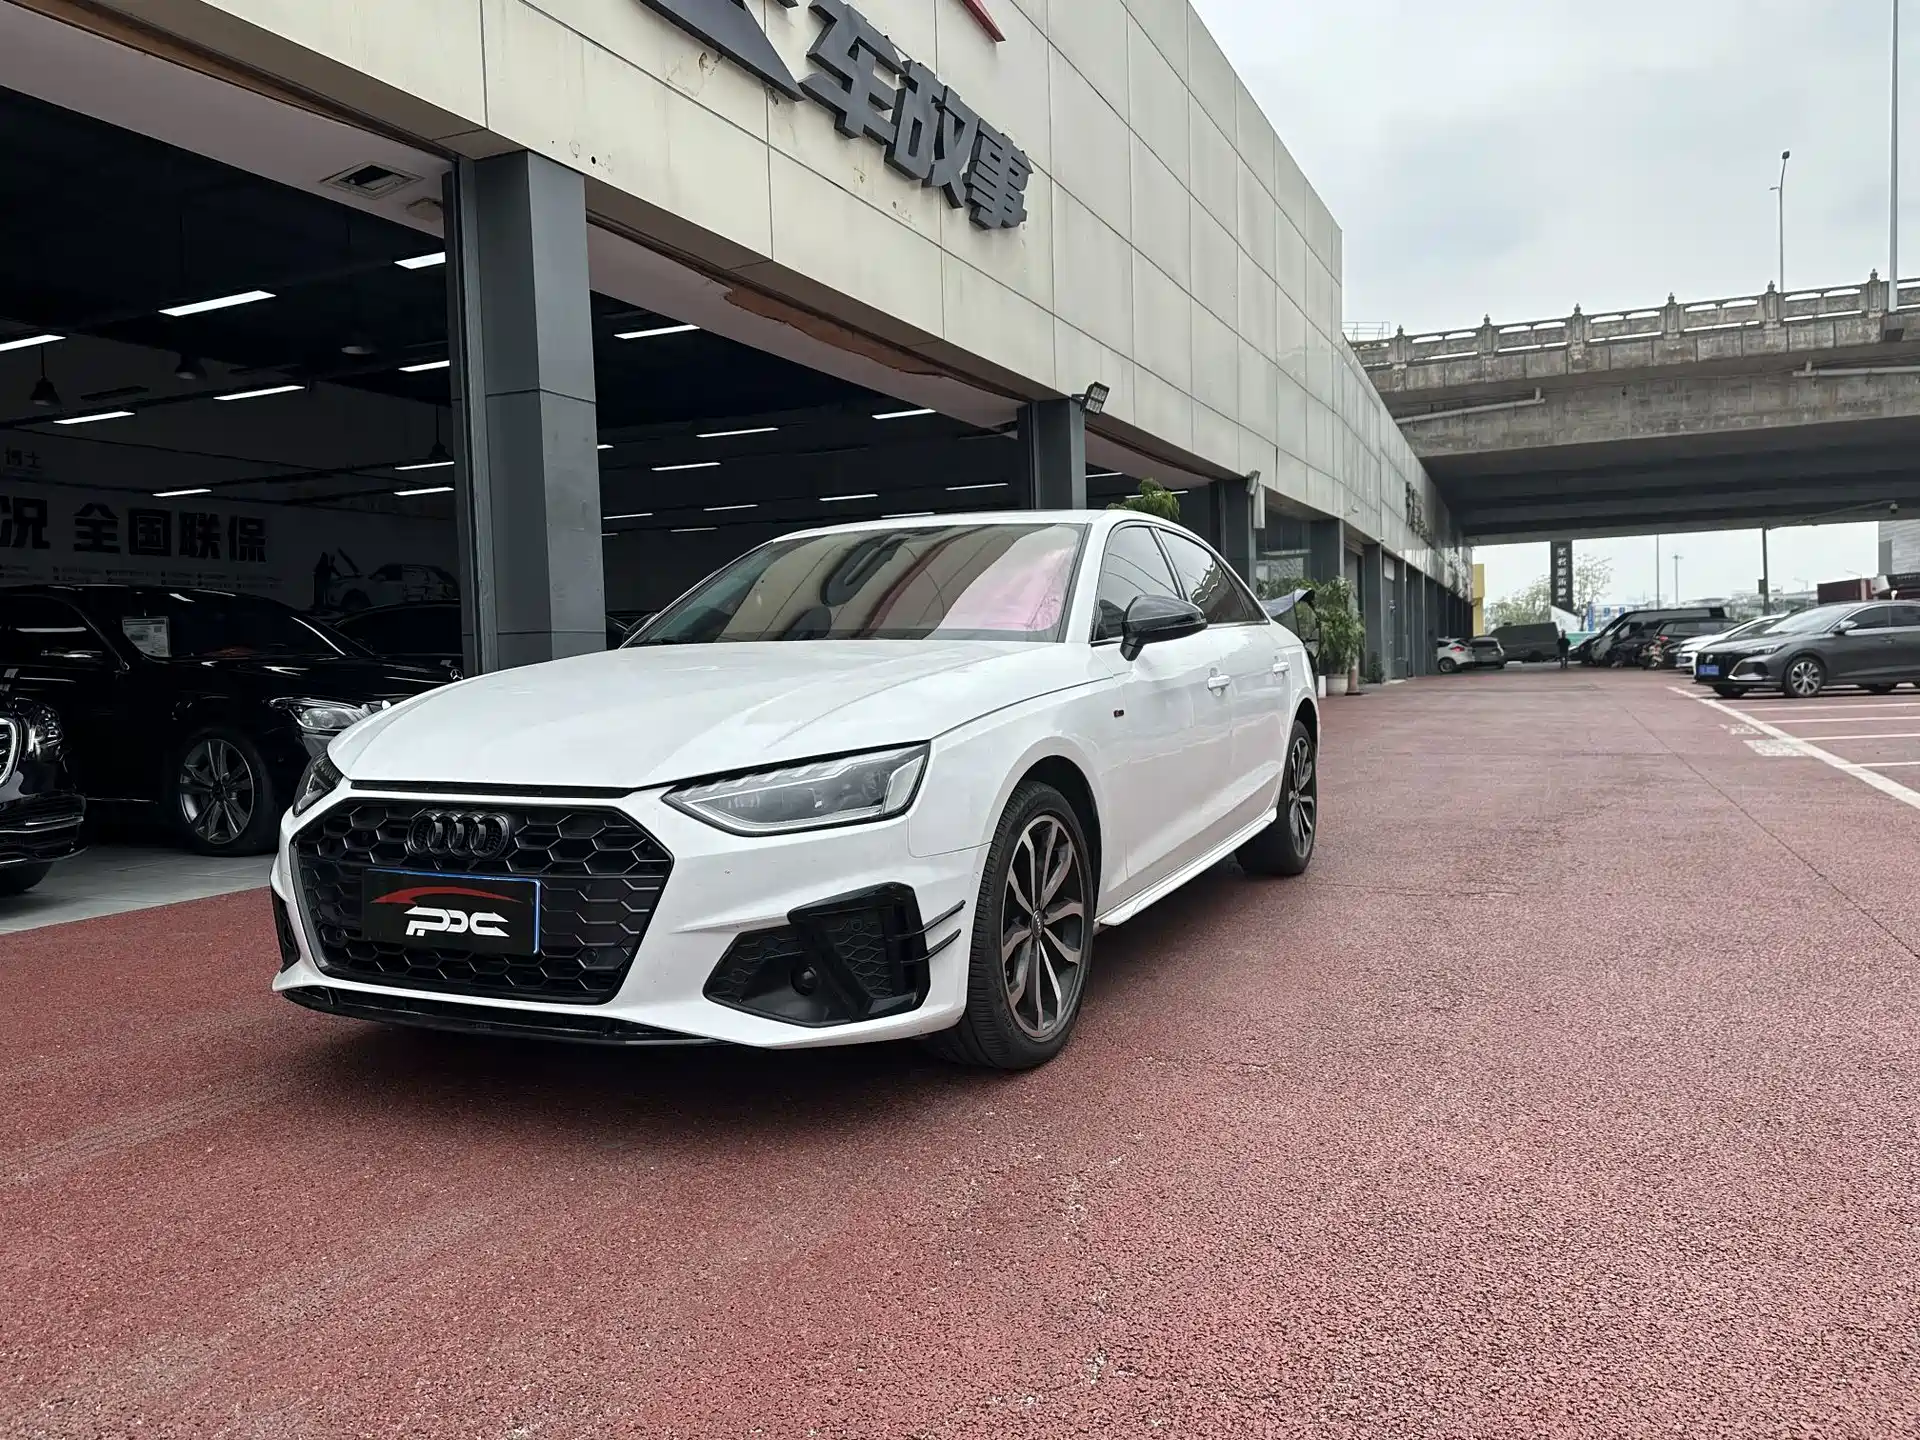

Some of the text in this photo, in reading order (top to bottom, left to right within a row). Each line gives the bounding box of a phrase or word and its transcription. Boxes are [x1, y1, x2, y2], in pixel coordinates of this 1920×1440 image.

[799, 0, 1034, 230] 车故事
[0, 495, 268, 563] 况 全国联保
